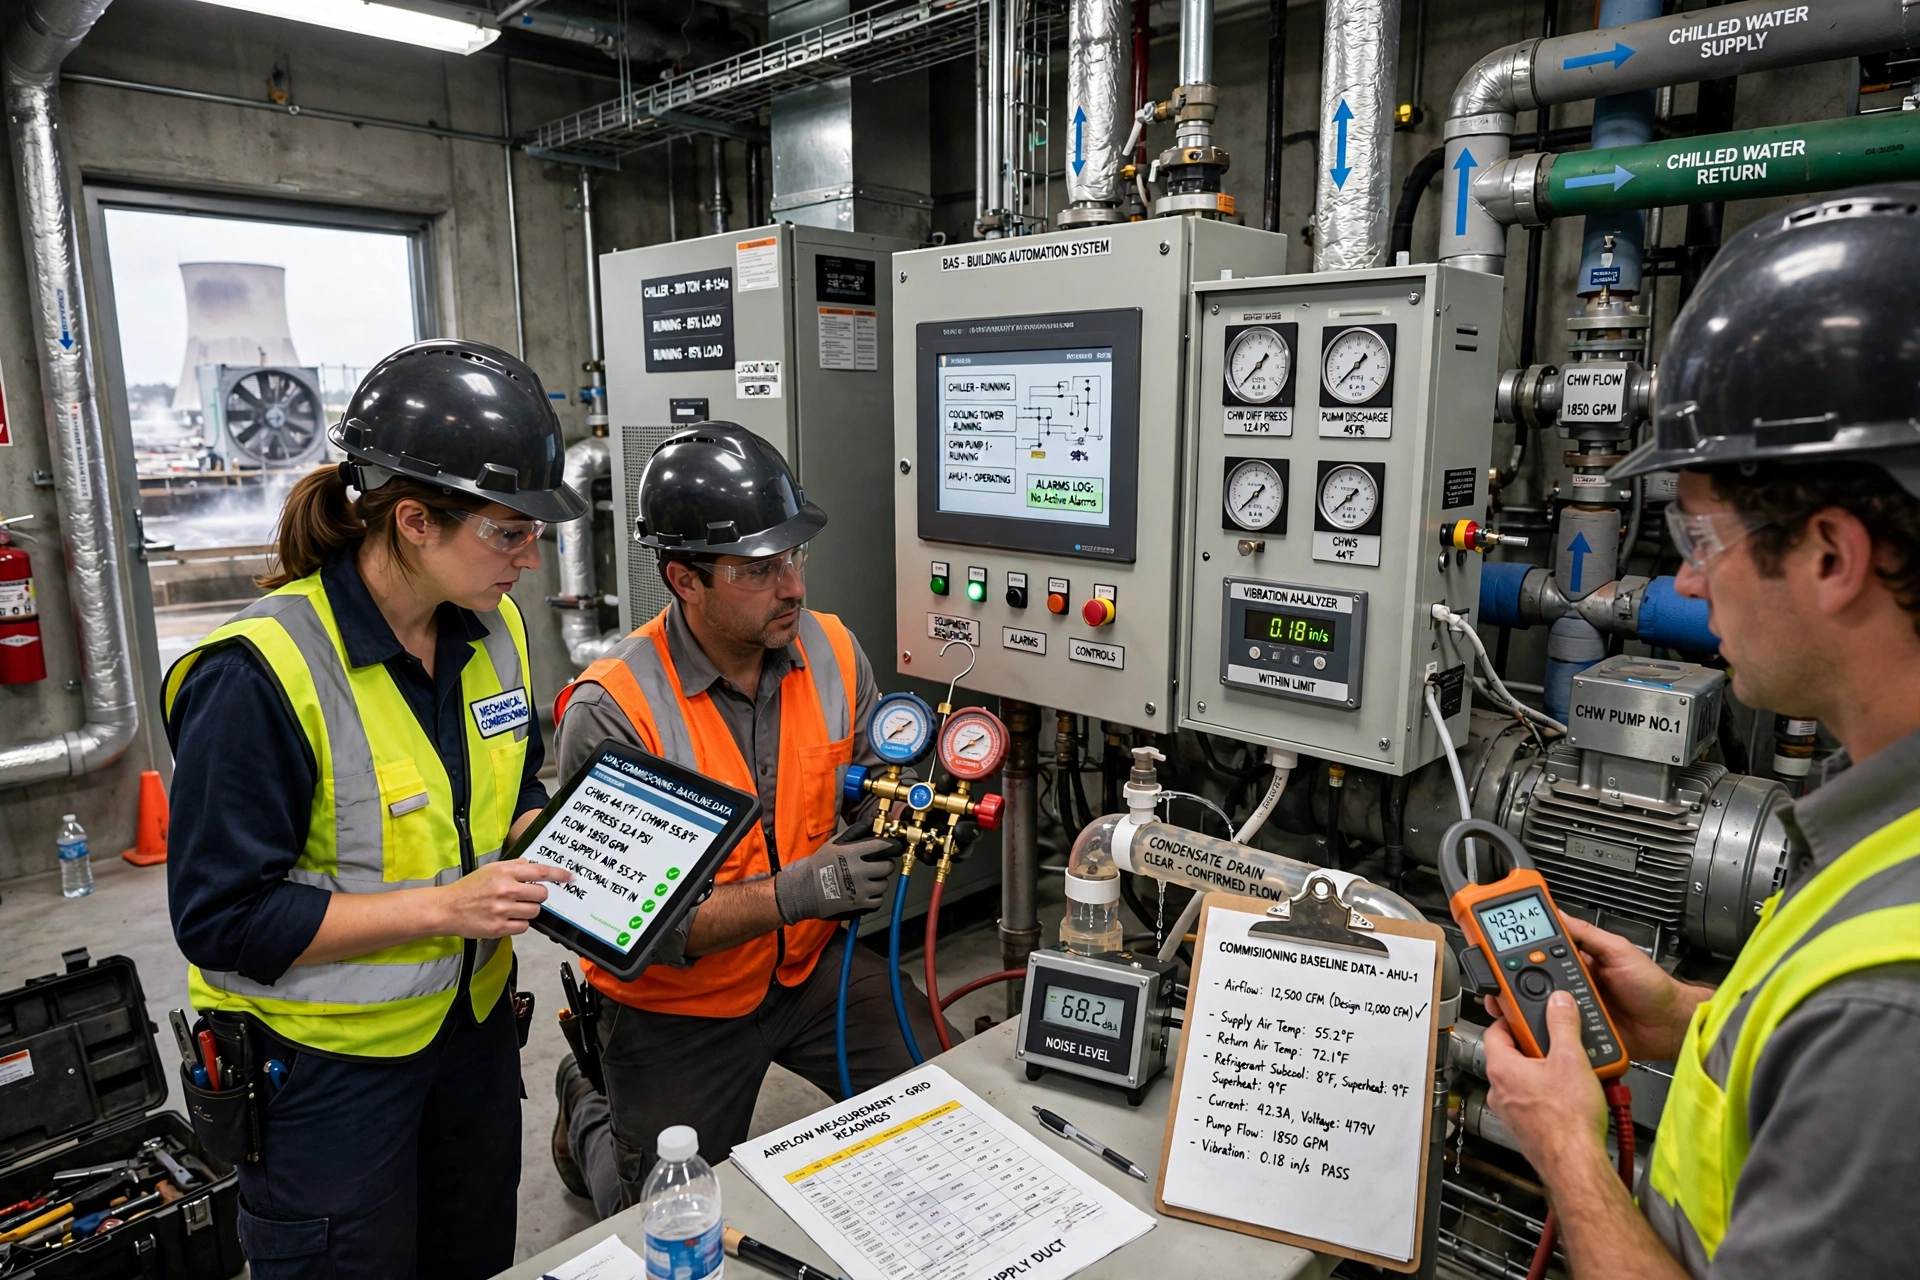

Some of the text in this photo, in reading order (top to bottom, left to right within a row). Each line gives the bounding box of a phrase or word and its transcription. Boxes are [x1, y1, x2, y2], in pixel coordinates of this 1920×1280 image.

[1669, 6, 1808, 45] CHILLED WATER
[1700, 32, 1768, 59] SUPPLY
[1666, 139, 1806, 171] CHILLED WATER
[1697, 162, 1767, 185] RETURN
[942, 240, 1110, 270] BAS BUILDING AUTOMATION SYSTEM
[701, 314, 722, 328] LOAD
[703, 344, 723, 358] LOAD
[1567, 373, 1623, 386] CHW FLOW
[980, 410, 1004, 420] TOWER
[1227, 410, 1244, 420] CHW
[1264, 411, 1288, 422] PRESS
[1345, 412, 1388, 423] DISCHARGE
[1567, 403, 1616, 416] 1850 GPM
[973, 474, 1011, 485] OPERATING
[1036, 479, 1094, 494] ALARMS LOG:
[1030, 492, 1097, 507] No Active Alarms
[1333, 536, 1358, 548] CHWS
[1243, 587, 1288, 603] VIBRATION
[1009, 633, 1039, 648] ALARMS
[1270, 618, 1329, 643] 0.18 in/s
[1075, 646, 1116, 662] CONTROLS
[1258, 673, 1316, 693] WITHIN LIMIT
[1575, 704, 1681, 734] CHW PUMP NO.1
[585, 786, 611, 803] CHWS
[641, 812, 670, 831] CHWR
[561, 815, 588, 834] FLOW
[608, 839, 629, 854] GPM
[573, 801, 594, 815] DIFF
[591, 809, 620, 828] PRESS
[636, 831, 654, 845] PSI
[548, 831, 570, 845] AHU
[567, 840, 602, 861] SUPPLY
[599, 856, 618, 870] AIR
[1150, 836, 1265, 880] CONDENSATE DRAIN
[1144, 852, 1174, 871] CLEAR
[1185, 864, 1246, 892] CONFIRMED
[1249, 884, 1283, 902] FLOW
[563, 882, 588, 900] NONE
[610, 882, 629, 897] TEST
[626, 891, 639, 903] IN
[1528, 907, 1540, 917] AC
[1499, 925, 1536, 945] 479 V
[1300, 953, 1349, 972] BASELINE
[1350, 962, 1377, 977] DATA
[1386, 968, 1418, 983] AHU-1
[1061, 995, 1106, 1026] 68.2
[1224, 979, 1413, 1021] Airflow: 12,500 CFM (Design 12,000 CFM)
[1220, 1010, 1355, 1044] Supply Air Temp: 55.2°F
[1045, 1036, 1111, 1062] NOISE LEVEL
[1218, 1031, 1350, 1064] Return Air Temp: 72.1°F
[1212, 1071, 1288, 1095] Superheat: 9°F
[1214, 1052, 1410, 1097] Refrigerant Subcool: 8°F, Superheat: 9°F
[763, 1081, 932, 1159] AIRFLOW MEASUREMENT GRID
[832, 1112, 892, 1141] READINGS
[1208, 1093, 1376, 1137] Current: 42.3A, Voltage: 479V
[1206, 1115, 1329, 1151] Pump Flow: 1850 GPM
[1202, 1138, 1350, 1181] Vibration: 0.18 in/s PASS
[988, 1238, 1067, 1280] PPLY DUCT
